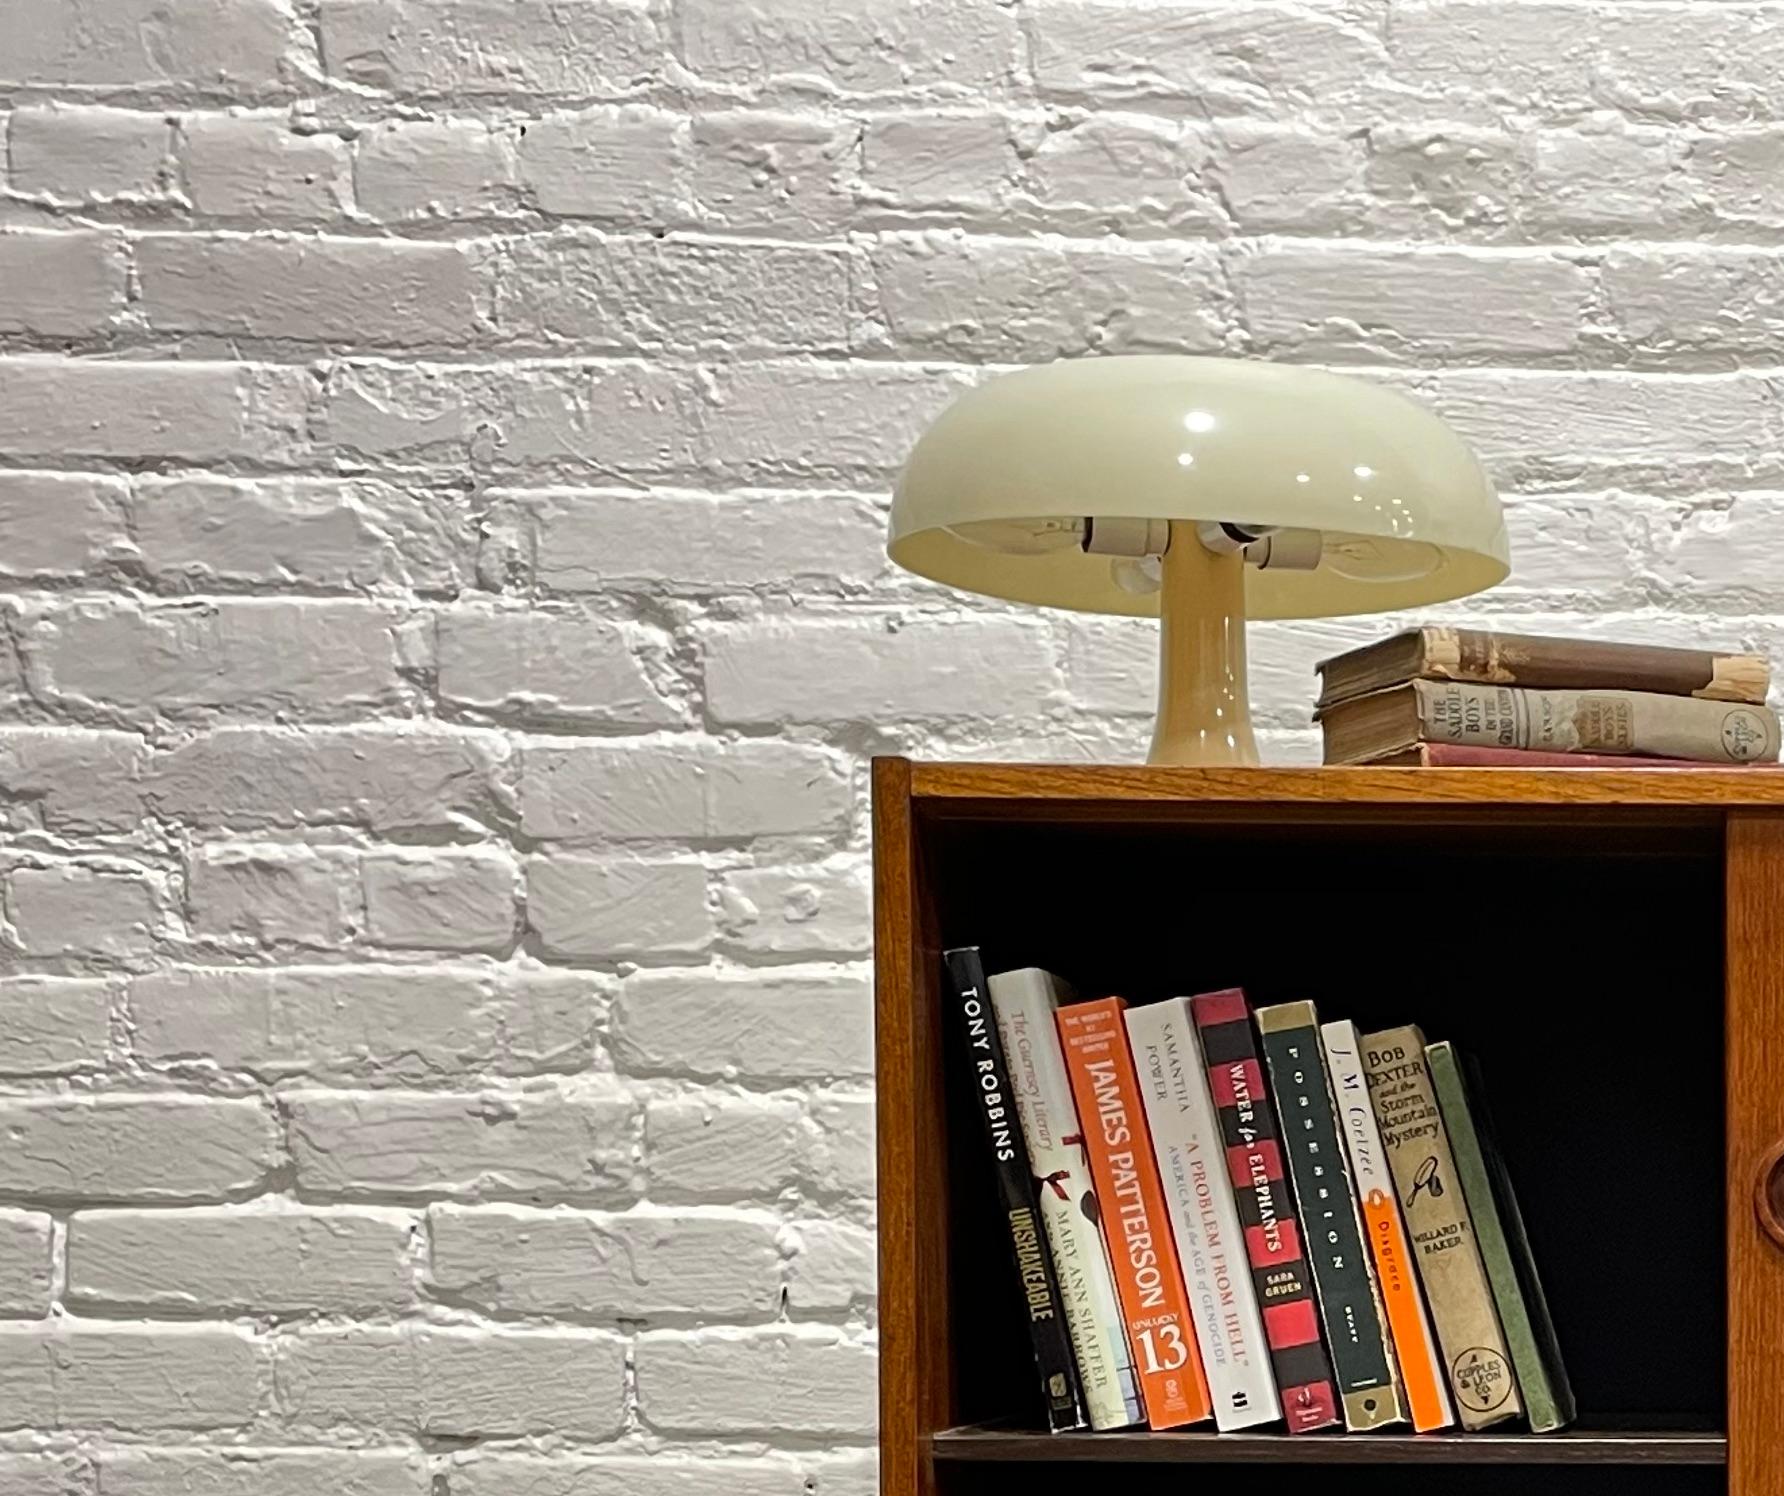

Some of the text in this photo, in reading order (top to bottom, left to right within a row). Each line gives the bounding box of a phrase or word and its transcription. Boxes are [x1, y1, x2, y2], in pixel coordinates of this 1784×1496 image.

[1434, 699, 1446, 725] THE
[1466, 697, 1480, 733] BOYS
[1011, 1010, 1028, 1038] The
[960, 985, 1015, 1163] TONY ROBBINS
[1016, 1038, 1042, 1098] Guernsey
[1146, 1044, 1168, 1102] POWER
[1161, 1021, 1189, 1115] SAMANTHA
[1365, 1062, 1423, 1089] DEXTER
[1367, 1046, 1405, 1068] BOB
[1085, 1058, 1132, 1145] JAMES
[1380, 1084, 1398, 1098] and
[1380, 1094, 1425, 1114] Storm
[1380, 1104, 1437, 1129] Mountain
[1032, 1101, 1054, 1152] Literary
[1350, 1107, 1375, 1177] Coetzee
[1383, 1121, 1439, 1149] Mystery
[1230, 1063, 1253, 1124] WATER
[1248, 1153, 1283, 1254] ELEPHANTS
[1108, 1152, 1166, 1309] PATTERSON
[1168, 1145, 1190, 1206] AMERICA
[1192, 1249, 1206, 1275] AGE
[1202, 1294, 1226, 1367] GENOCIDE
[1190, 1160, 1222, 1249] PROBLEM
[1210, 1252, 1234, 1307] FROM
[1424, 1236, 1464, 1254] BAKER
[1008, 1207, 1054, 1323] UNSHAKEABLE
[1265, 1282, 1302, 1298] GRUEN
[1266, 1272, 1294, 1285] SARA
[1056, 1209, 1108, 1389] MARY ANN SHAFFER
[1136, 1324, 1187, 1375] 13
